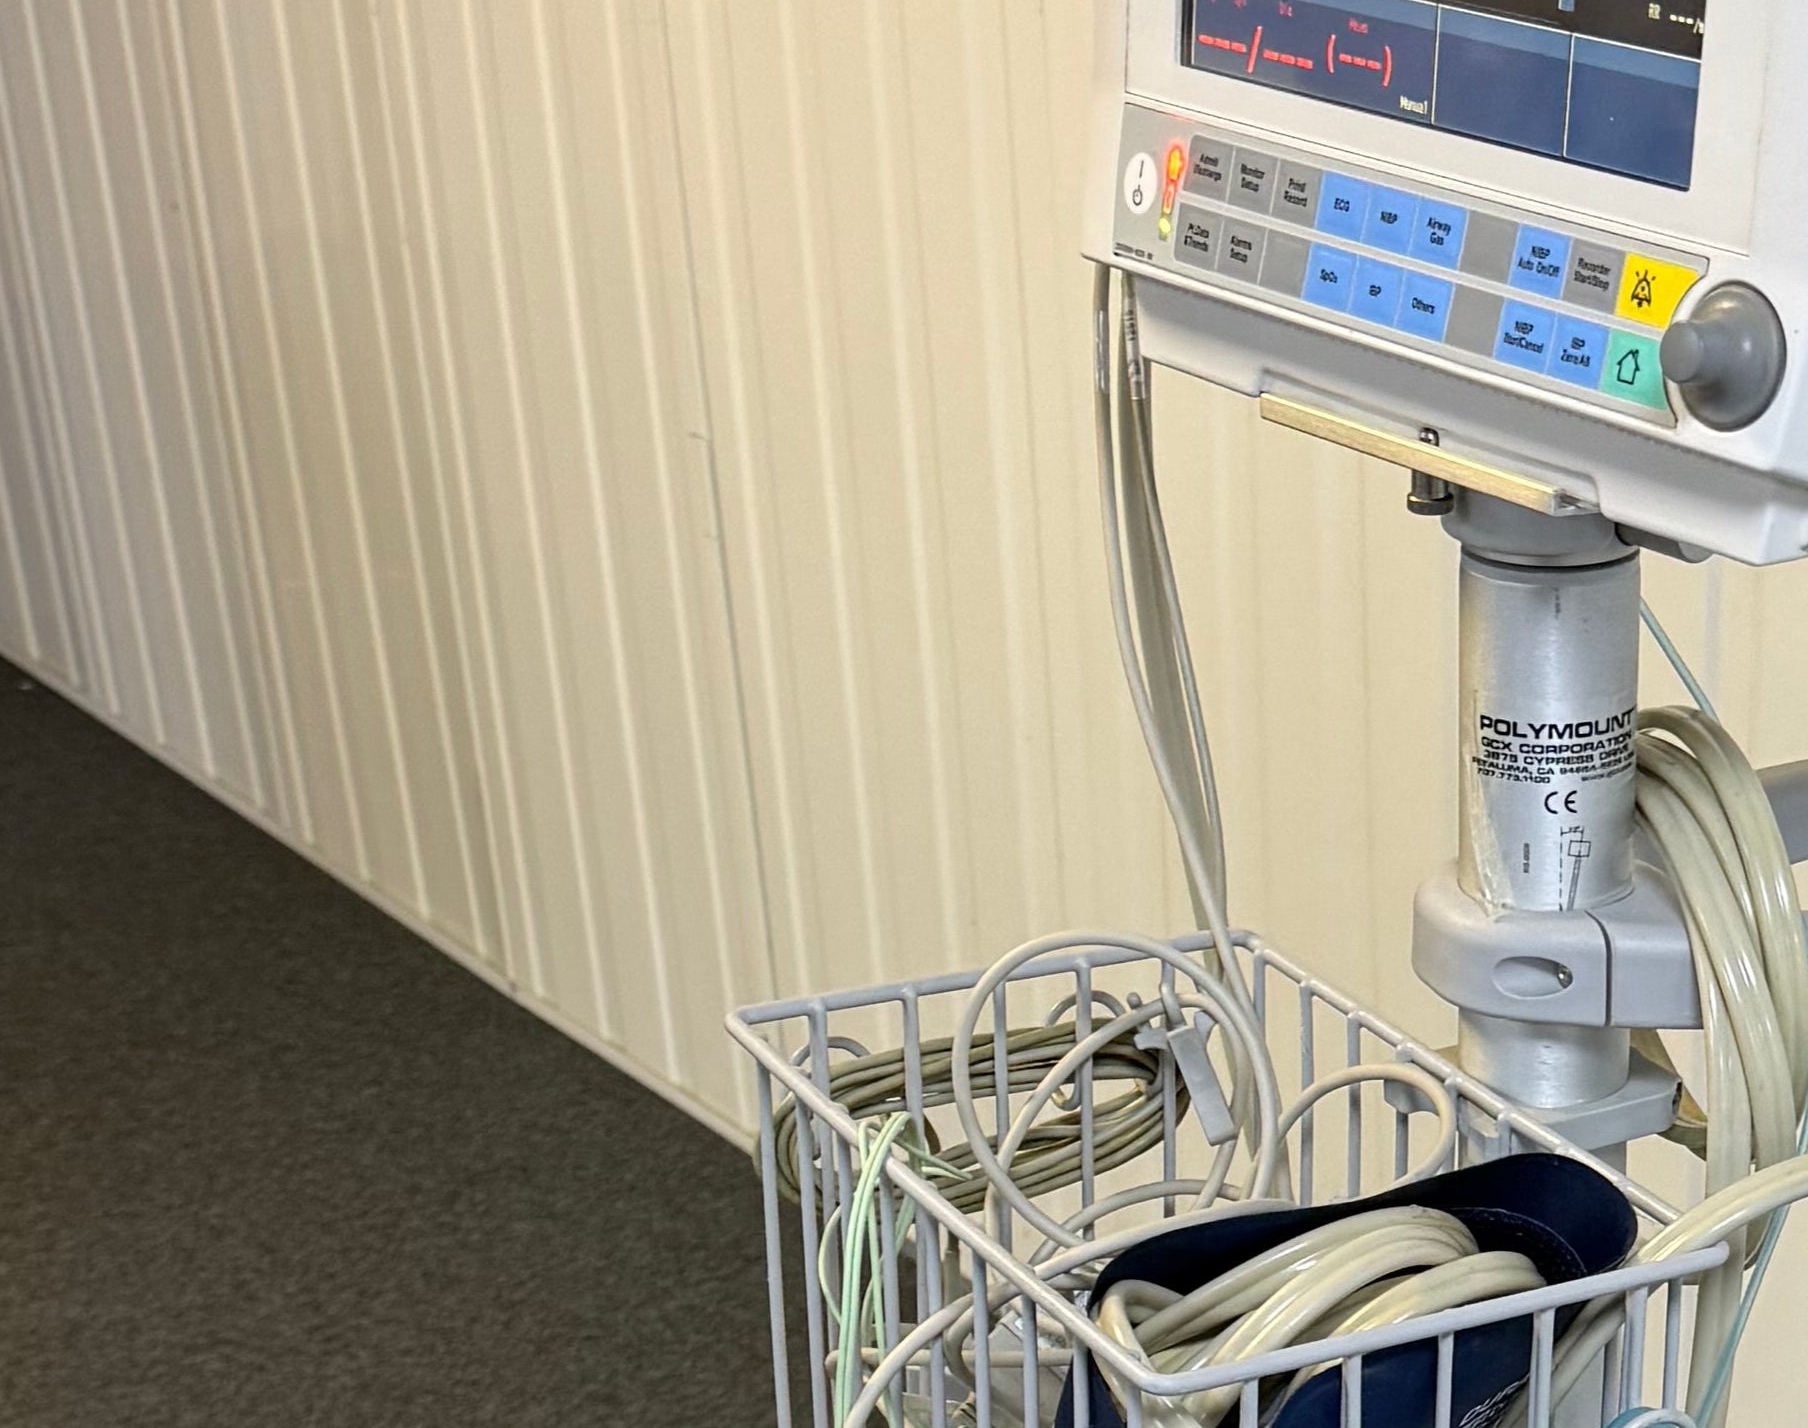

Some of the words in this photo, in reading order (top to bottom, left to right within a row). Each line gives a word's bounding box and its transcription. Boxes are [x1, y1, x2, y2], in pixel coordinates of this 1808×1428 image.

[1334, 197, 1350, 212] ECG
[1427, 217, 1451, 236] Airway
[1430, 232, 1445, 246] Gas
[1411, 297, 1436, 315] Others
[1480, 707, 1635, 739] POLYMOUNT
[1481, 736, 1512, 752] GCX
[1519, 732, 1632, 754] CORPORATION
[1524, 752, 1594, 765] CYPRESS
[1537, 766, 1555, 775] CA
